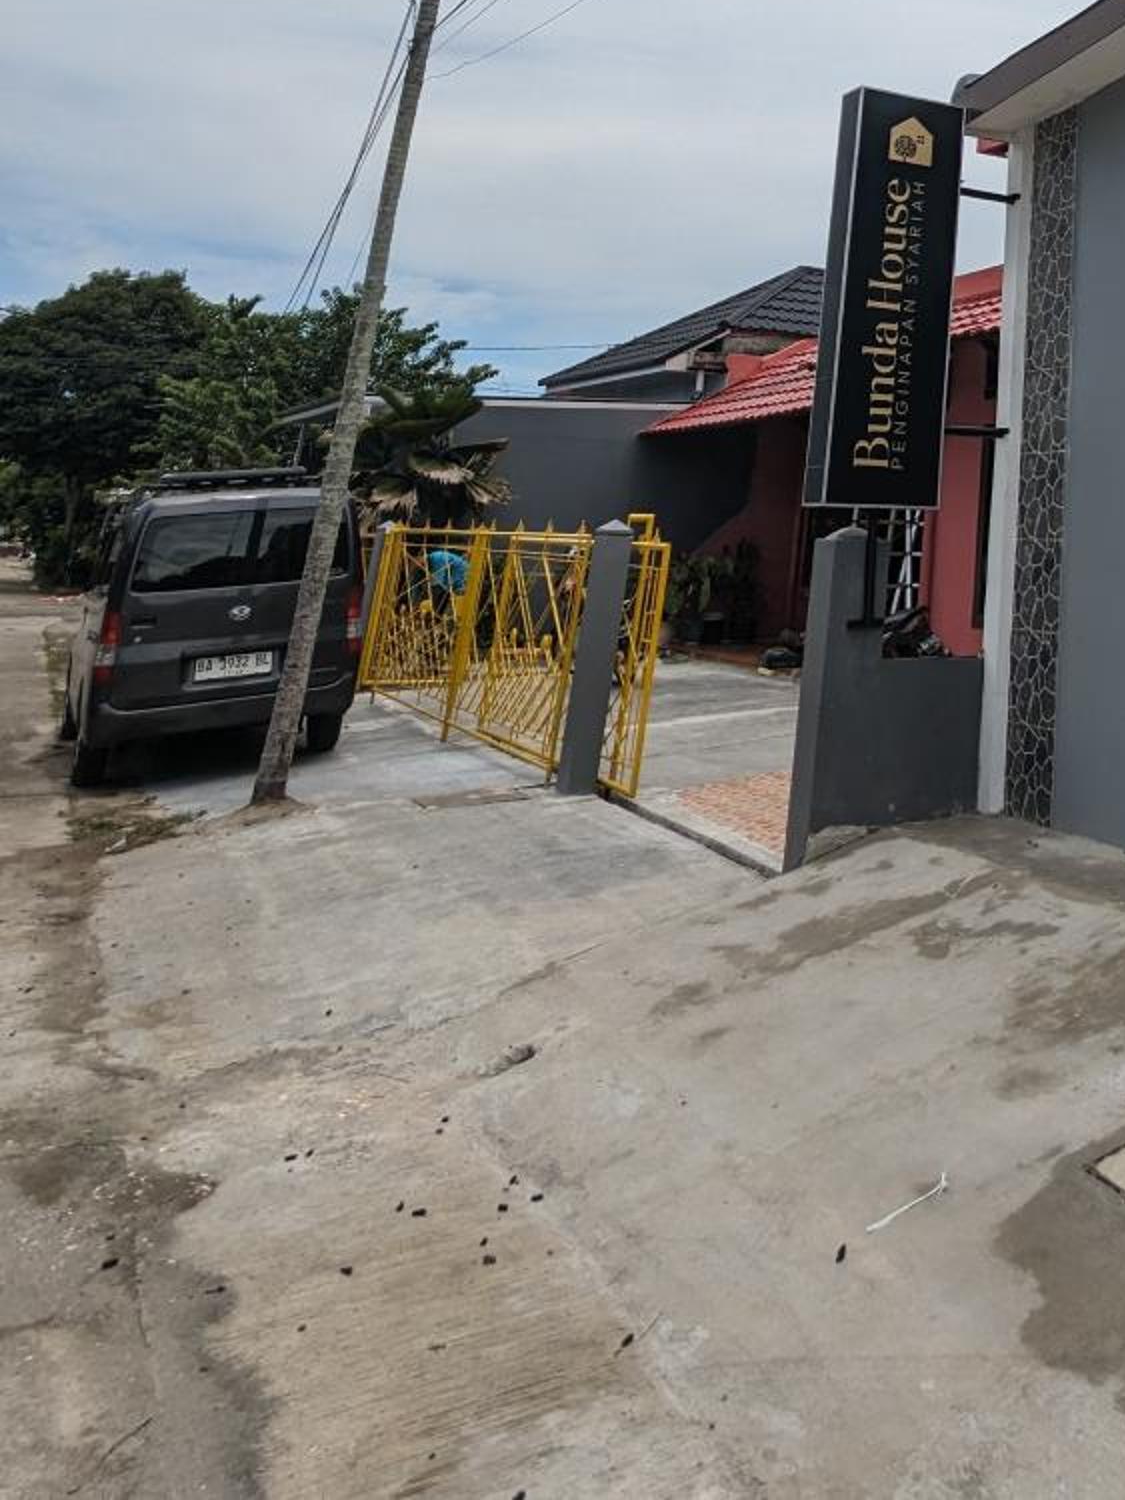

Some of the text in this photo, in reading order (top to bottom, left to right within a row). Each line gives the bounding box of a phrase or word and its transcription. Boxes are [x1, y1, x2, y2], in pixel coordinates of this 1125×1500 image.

[853, 179, 911, 467] Bunda House
[890, 181, 926, 470] PENGINAPAN SYARIAH
